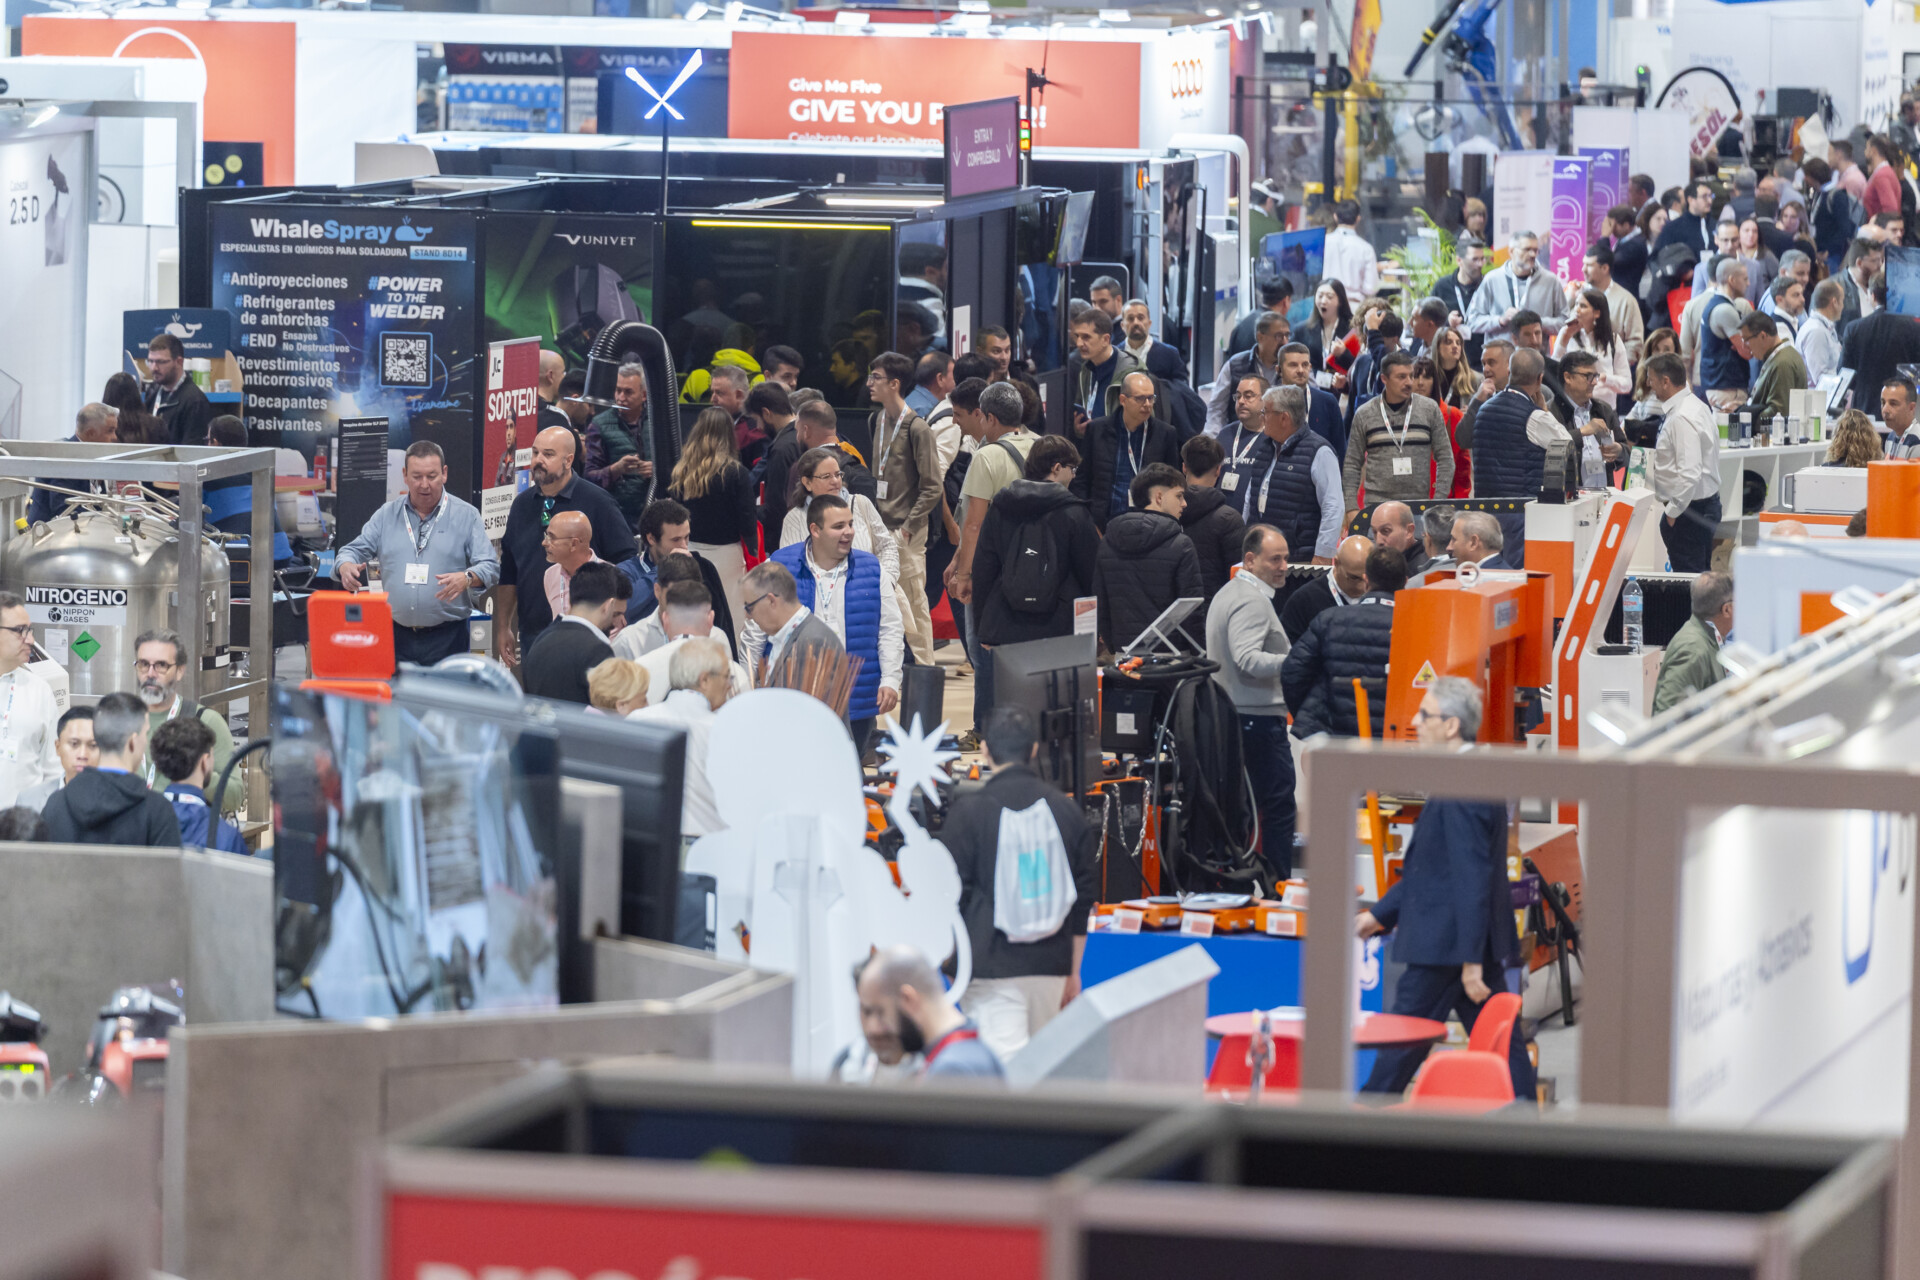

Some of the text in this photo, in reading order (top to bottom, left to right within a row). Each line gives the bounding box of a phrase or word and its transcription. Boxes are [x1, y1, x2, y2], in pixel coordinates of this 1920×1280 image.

[482, 51, 553, 65] VIRMA
[600, 53, 672, 67] VIRMA
[789, 77, 882, 94] Give Me Five
[789, 98, 856, 123] GIVE
[860, 99, 922, 125] YOU
[10, 195, 40, 225] 2.5 D
[250, 218, 392, 244] WhaleSpray
[220, 243, 407, 257] ESPECIALISTAS EN QUÍMICOS PARA SOLDADURA
[414, 249, 440, 258] STAND
[222, 271, 348, 289] #Antiproyecciones
[368, 275, 443, 292] #POWER
[234, 294, 335, 311] #Refrigerantes
[387, 293, 427, 304] TO THE
[240, 311, 329, 327] de antorchas
[370, 304, 445, 320] WELDER
[240, 333, 277, 348] #END
[282, 331, 318, 341] Ensayos
[282, 343, 350, 353] No Destructivos
[243, 371, 333, 388] nticorrosivos
[487, 386, 537, 422] SORTEO!
[484, 517, 494, 530] SLF
[26, 586, 127, 605] NITROGENO
[63, 608, 95, 616] NIPPON
